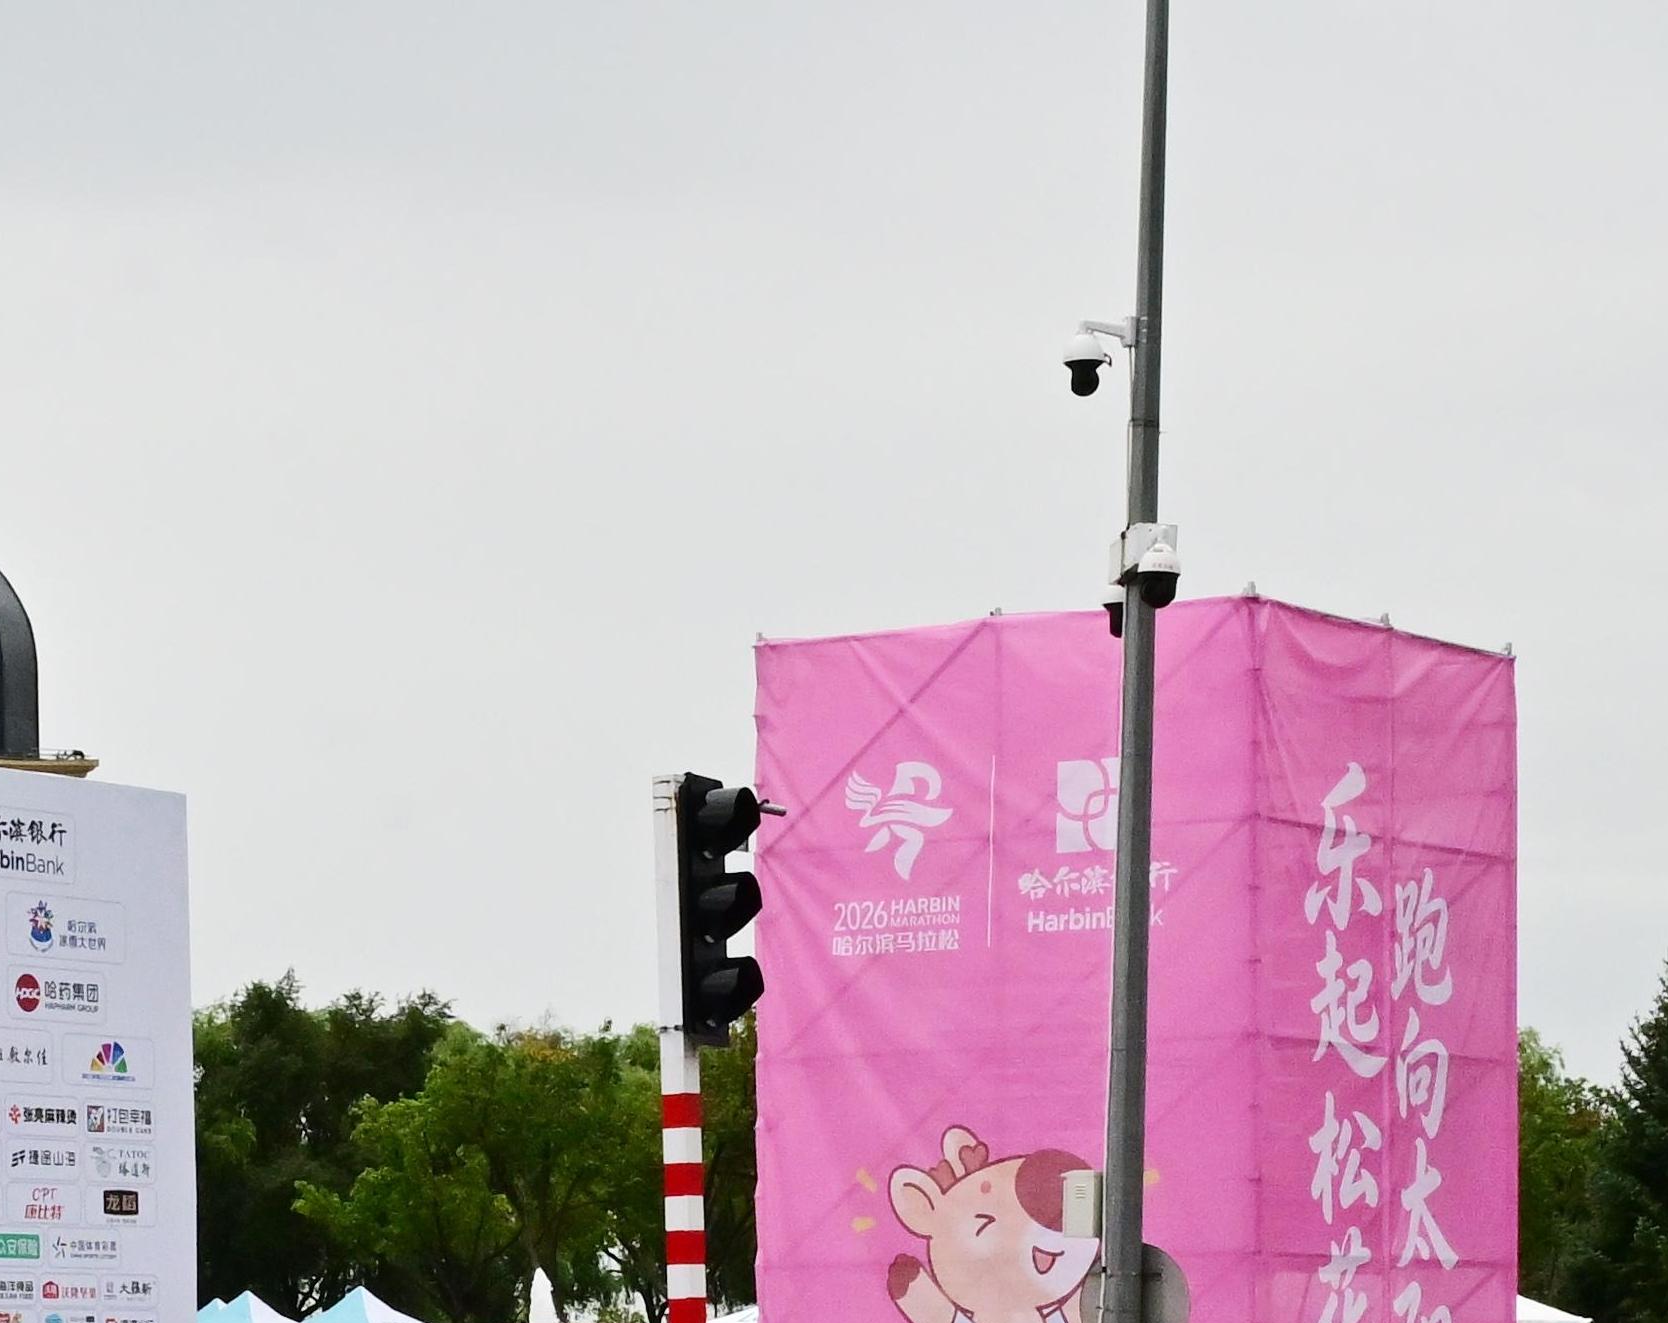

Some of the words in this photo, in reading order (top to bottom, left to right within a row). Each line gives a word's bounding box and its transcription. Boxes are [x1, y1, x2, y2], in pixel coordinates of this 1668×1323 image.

[1018, 862, 1178, 900] 哈尔滨行
[833, 901, 888, 932] 2026
[891, 896, 960, 916] HARBIN
[891, 913, 960, 928] MARATHON
[832, 930, 960, 957] 哈尔滨马拉松
[44, 981, 99, 1003] 哈药集团
[23, 1106, 77, 1125] 张亮麻辣烫
